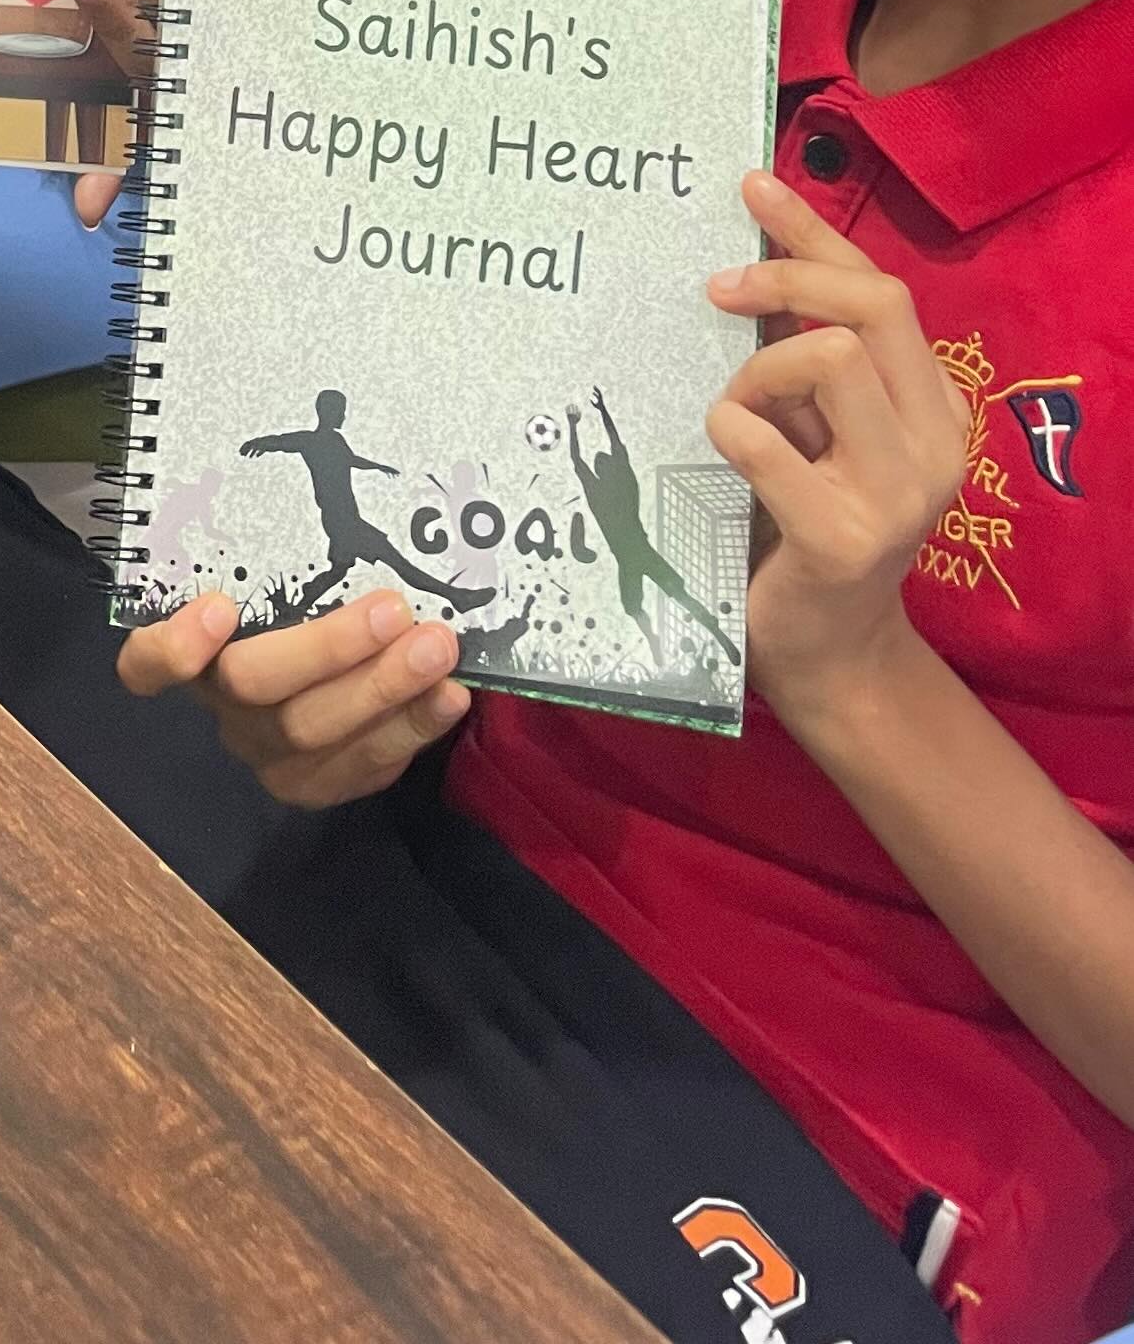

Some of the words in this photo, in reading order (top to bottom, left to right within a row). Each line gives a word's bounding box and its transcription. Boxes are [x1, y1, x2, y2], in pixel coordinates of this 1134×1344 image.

[227, 86, 448, 190] Happy
[487, 115, 694, 198] Heart
[313, 204, 585, 295] Journal
[410, 499, 598, 565] GOAL
